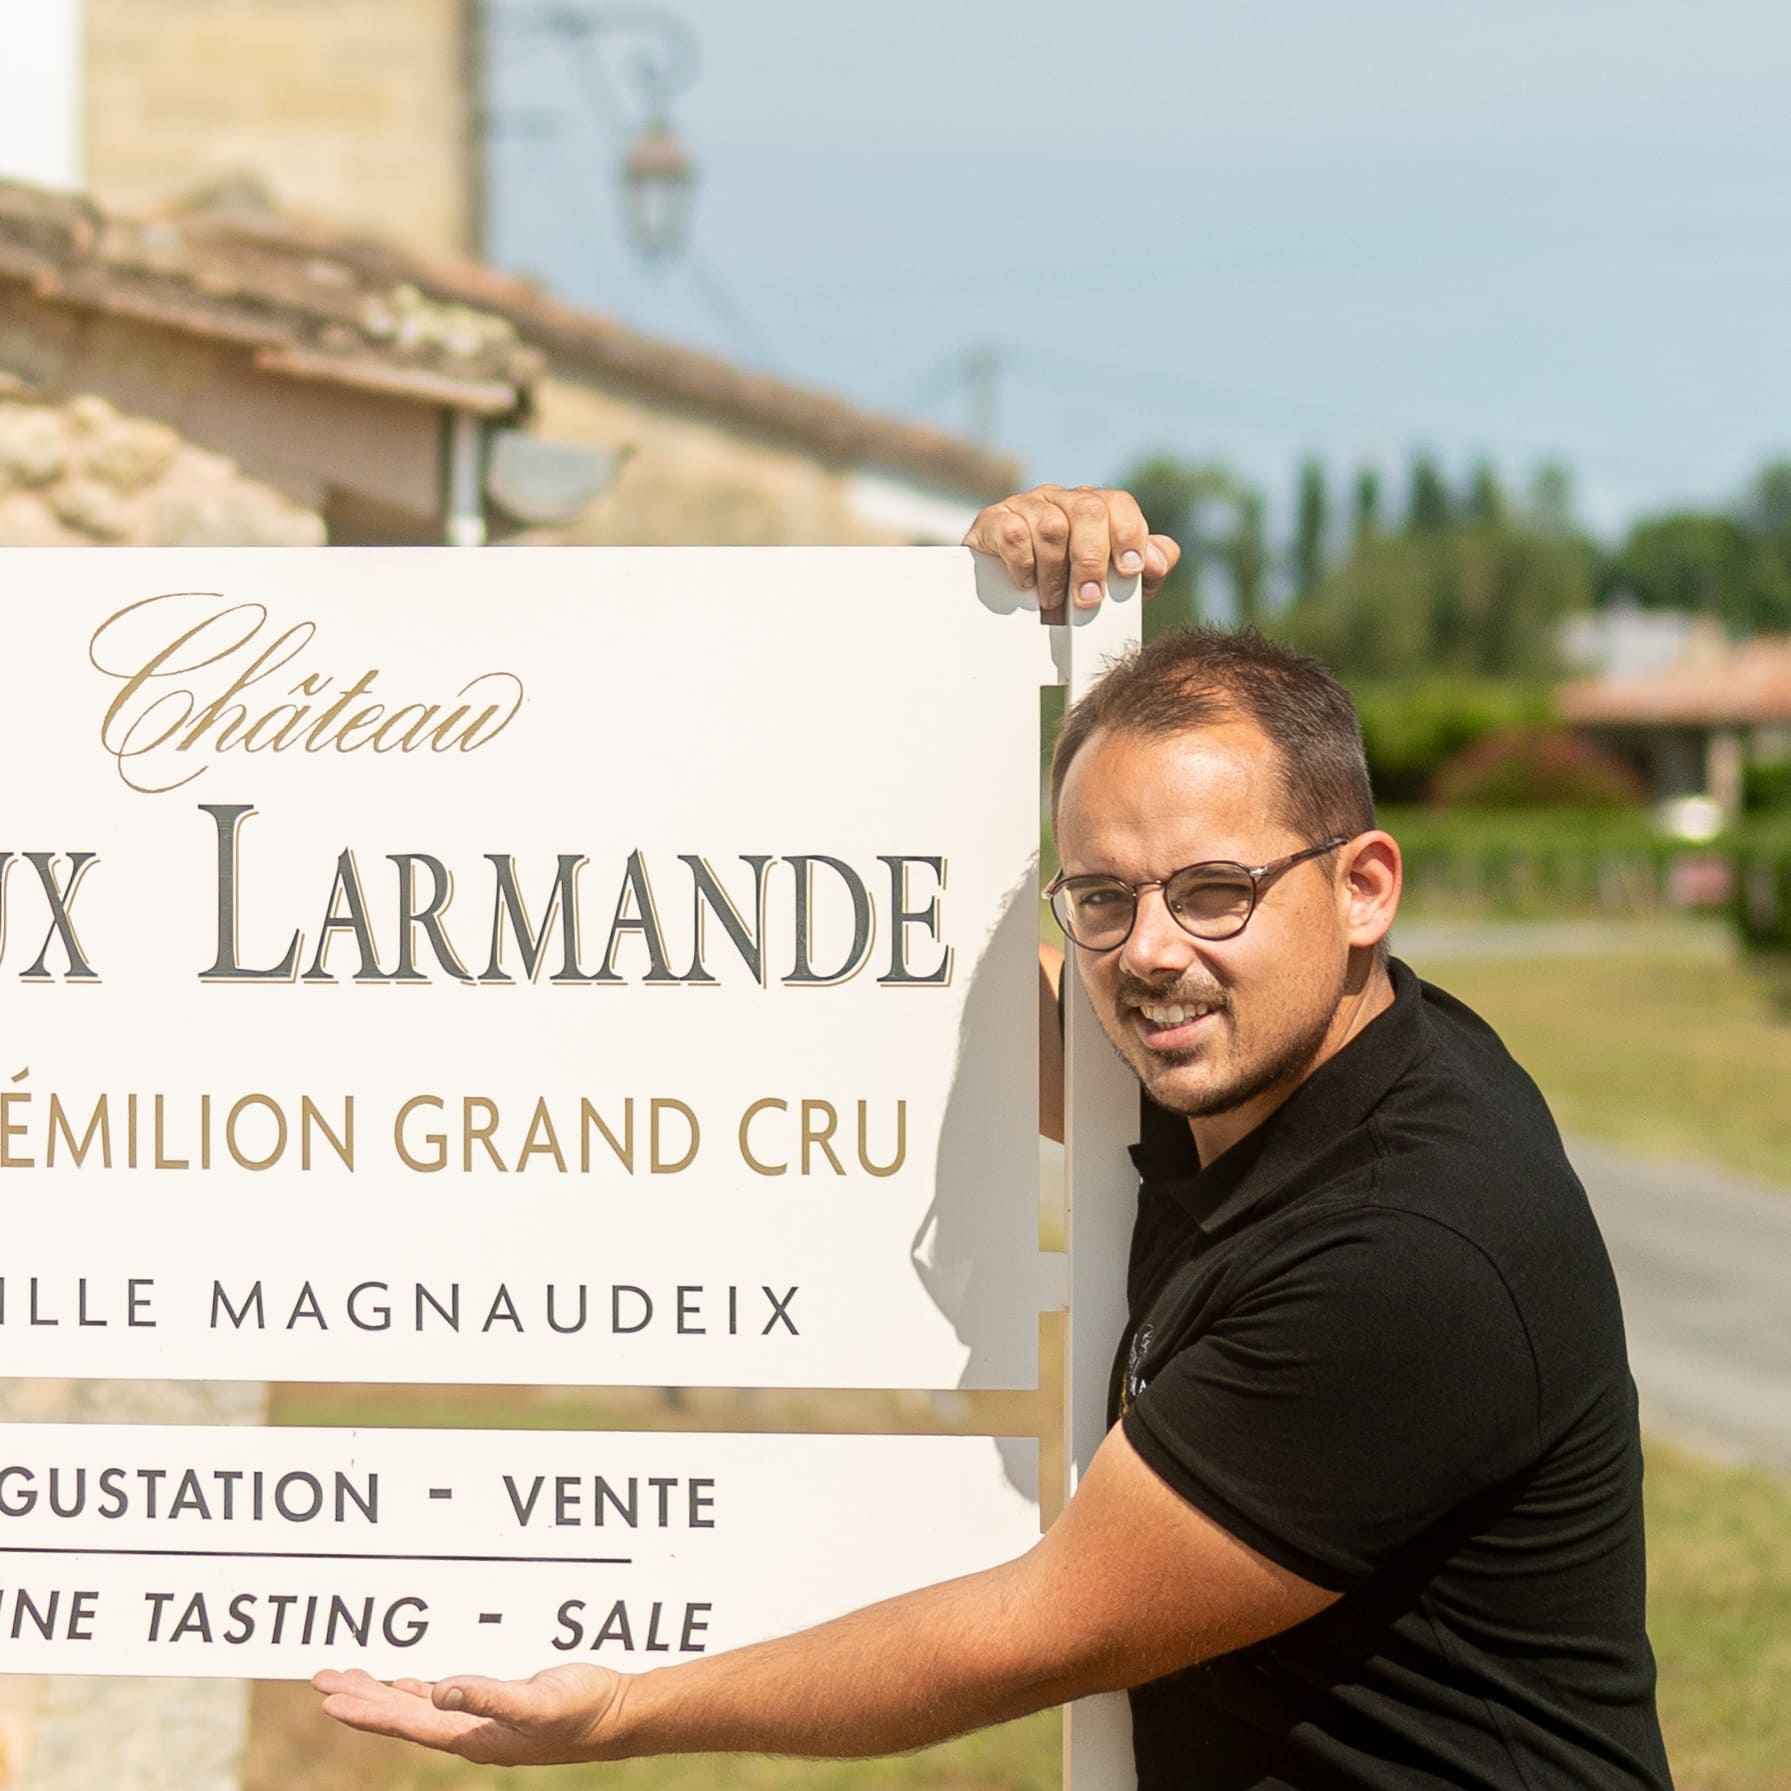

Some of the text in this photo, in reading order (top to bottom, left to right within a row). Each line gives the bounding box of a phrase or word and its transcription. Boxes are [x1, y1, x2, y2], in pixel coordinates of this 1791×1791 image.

[89, 593, 523, 794] Château
[198, 804, 956, 988] LARMANDE
[394, 1095, 702, 1176] GRAND
[739, 1097, 908, 1178] CRU
[210, 1280, 803, 1336] MAGNAUDEIX
[501, 1475, 718, 1529] VENTE
[144, 1591, 431, 1649] TASTING
[551, 1600, 714, 1653] SALE
